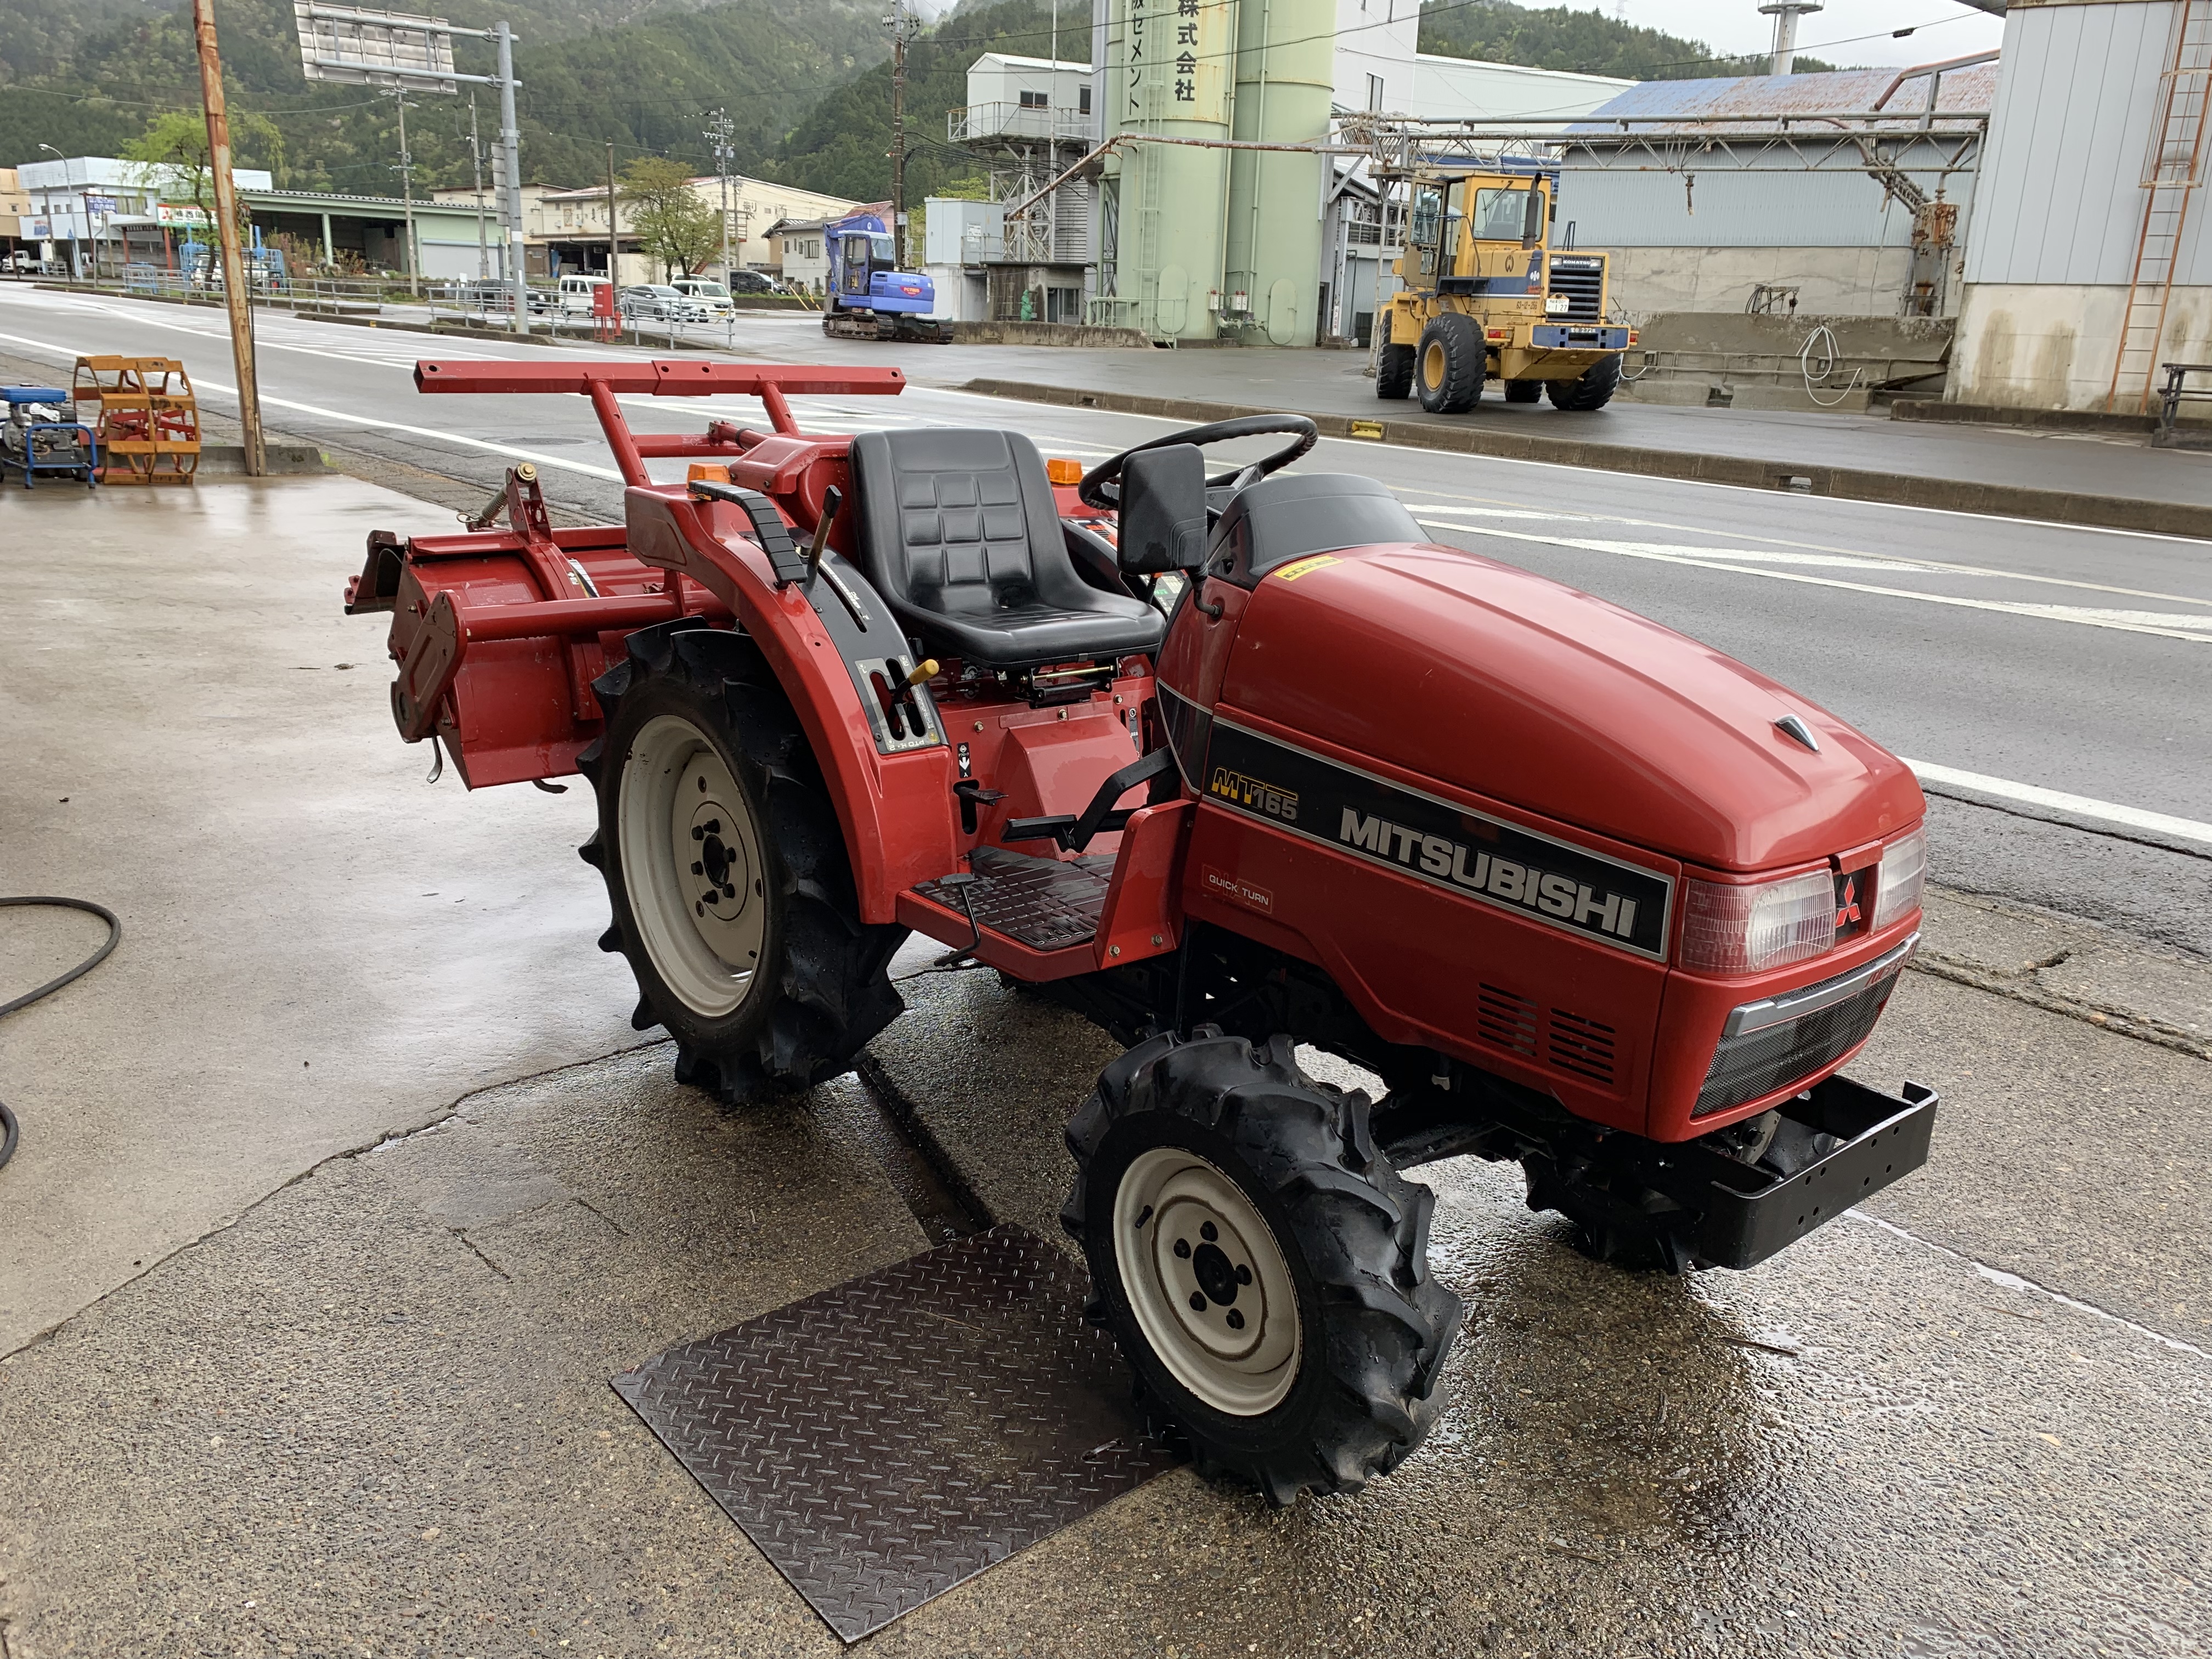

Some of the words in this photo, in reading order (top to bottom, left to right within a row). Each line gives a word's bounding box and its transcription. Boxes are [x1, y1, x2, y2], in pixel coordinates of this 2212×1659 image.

[1175, 0, 1200, 101] 株式会社
[1209, 874, 1238, 893] QUICK
[1242, 887, 1269, 906] TURN
[1340, 807, 1637, 938] MITSUBISHI
